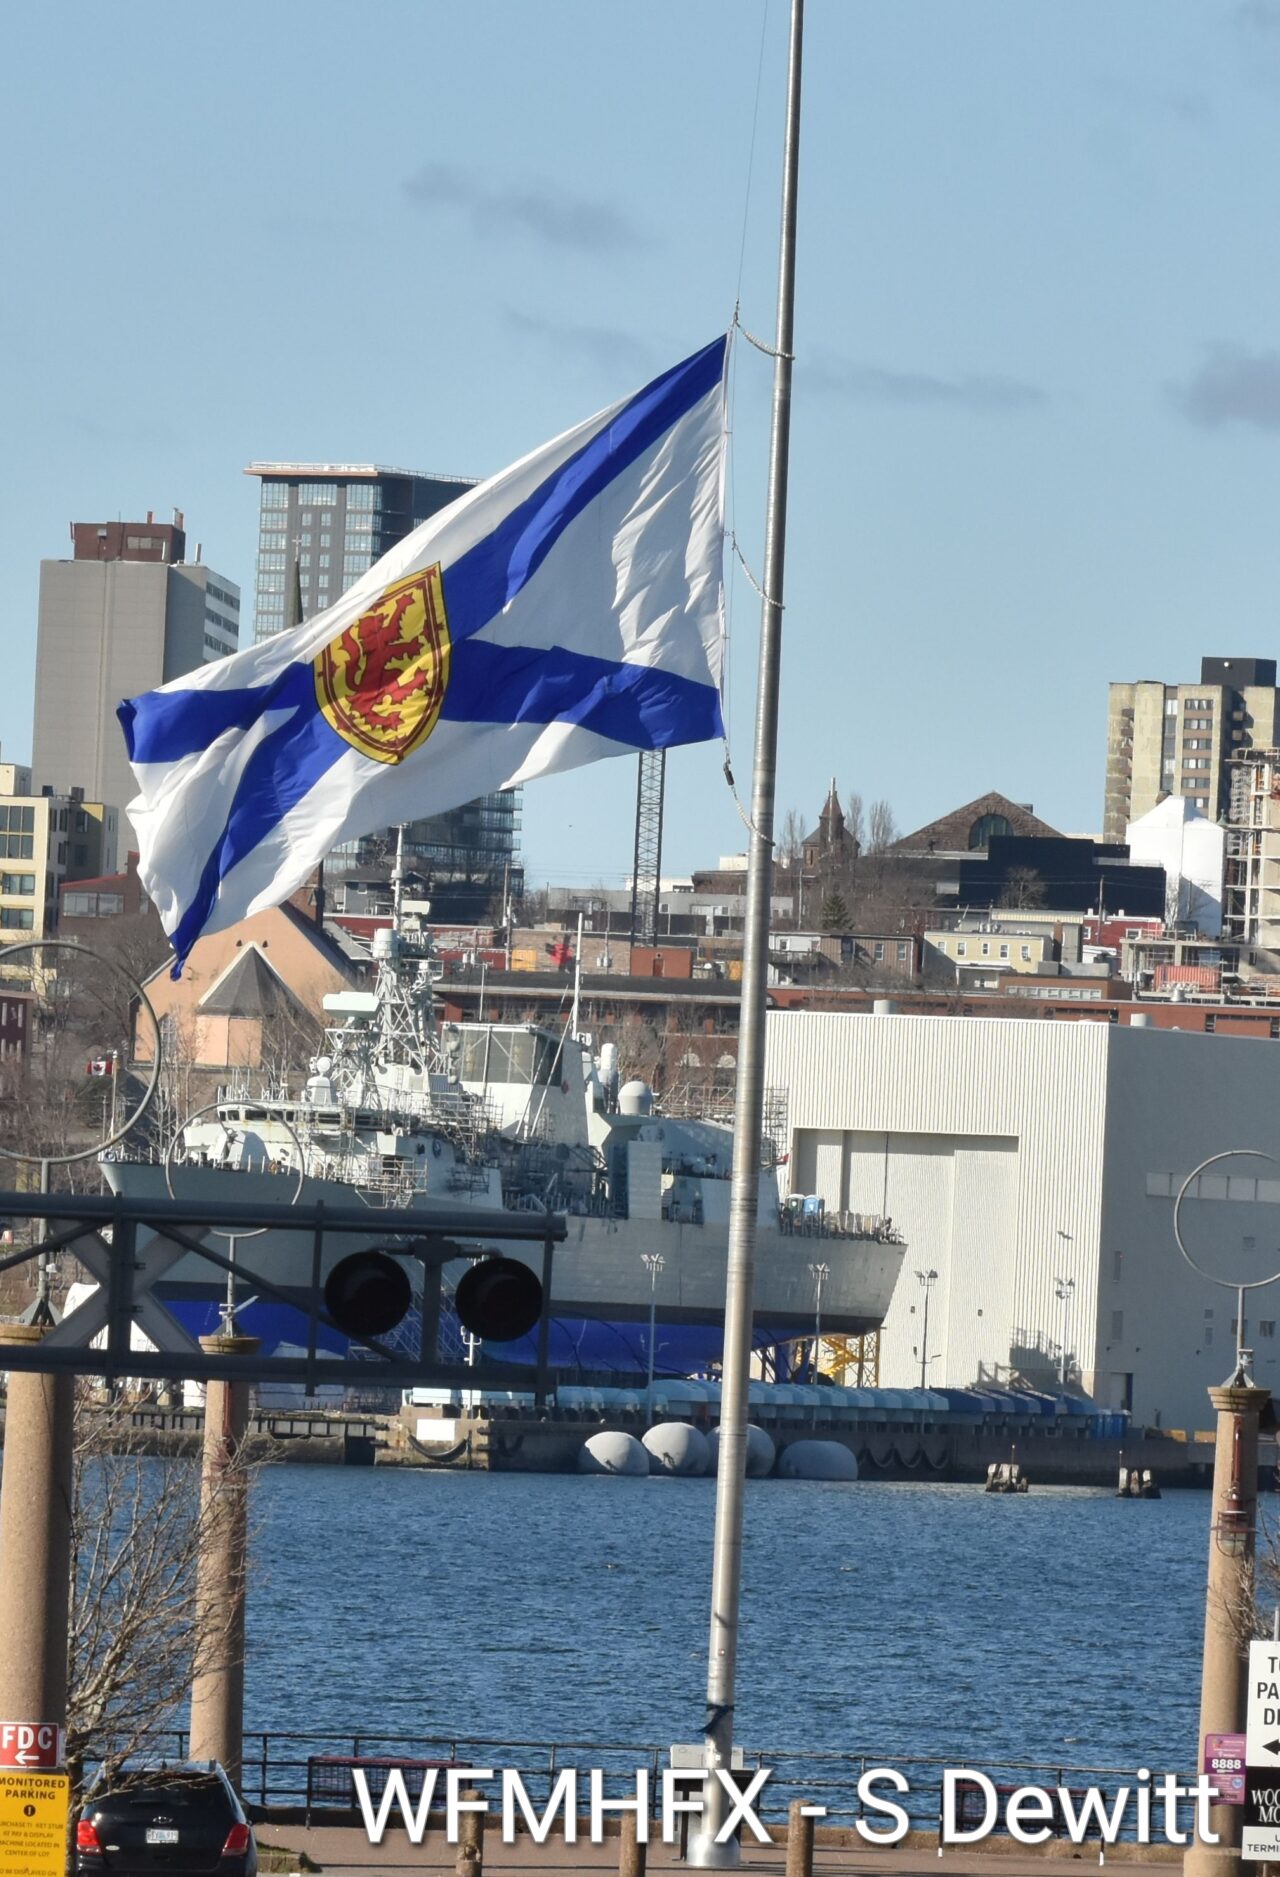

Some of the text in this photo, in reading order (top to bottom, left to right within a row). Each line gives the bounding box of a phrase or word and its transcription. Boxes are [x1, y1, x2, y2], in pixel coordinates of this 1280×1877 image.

[1267, 1656, 1280, 1674] T
[2, 1726, 52, 1750] FDC
[1211, 1758, 1241, 1770] 8888
[5, 1789, 56, 1800] PARKING
